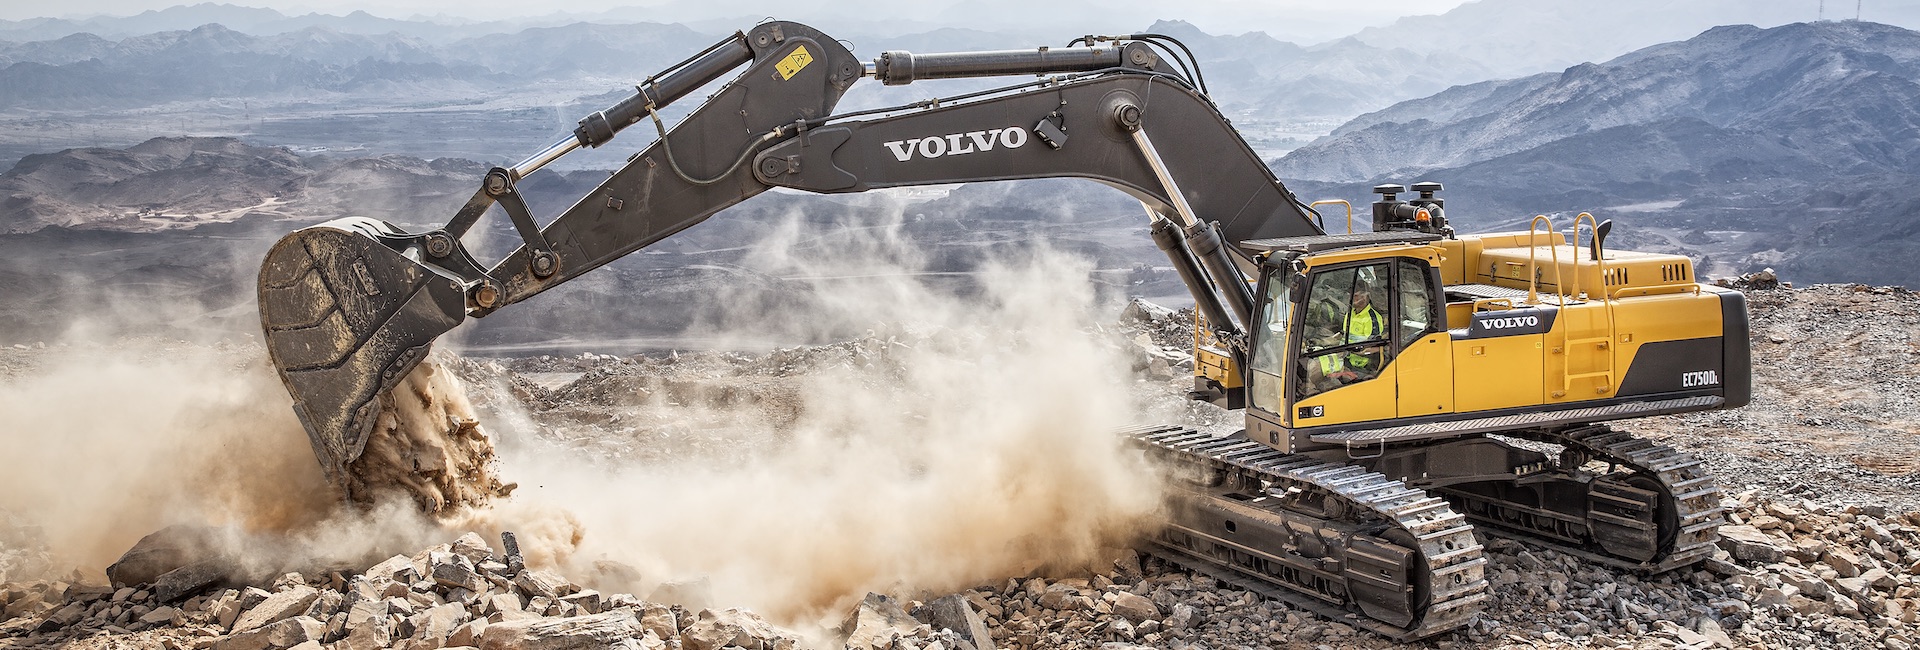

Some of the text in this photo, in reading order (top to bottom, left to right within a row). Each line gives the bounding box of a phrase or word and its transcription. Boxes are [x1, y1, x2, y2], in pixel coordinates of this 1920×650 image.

[883, 126, 1028, 162] VOLVO
[1480, 315, 1538, 330] VOLVO
[1682, 370, 1719, 387] EC750DL
